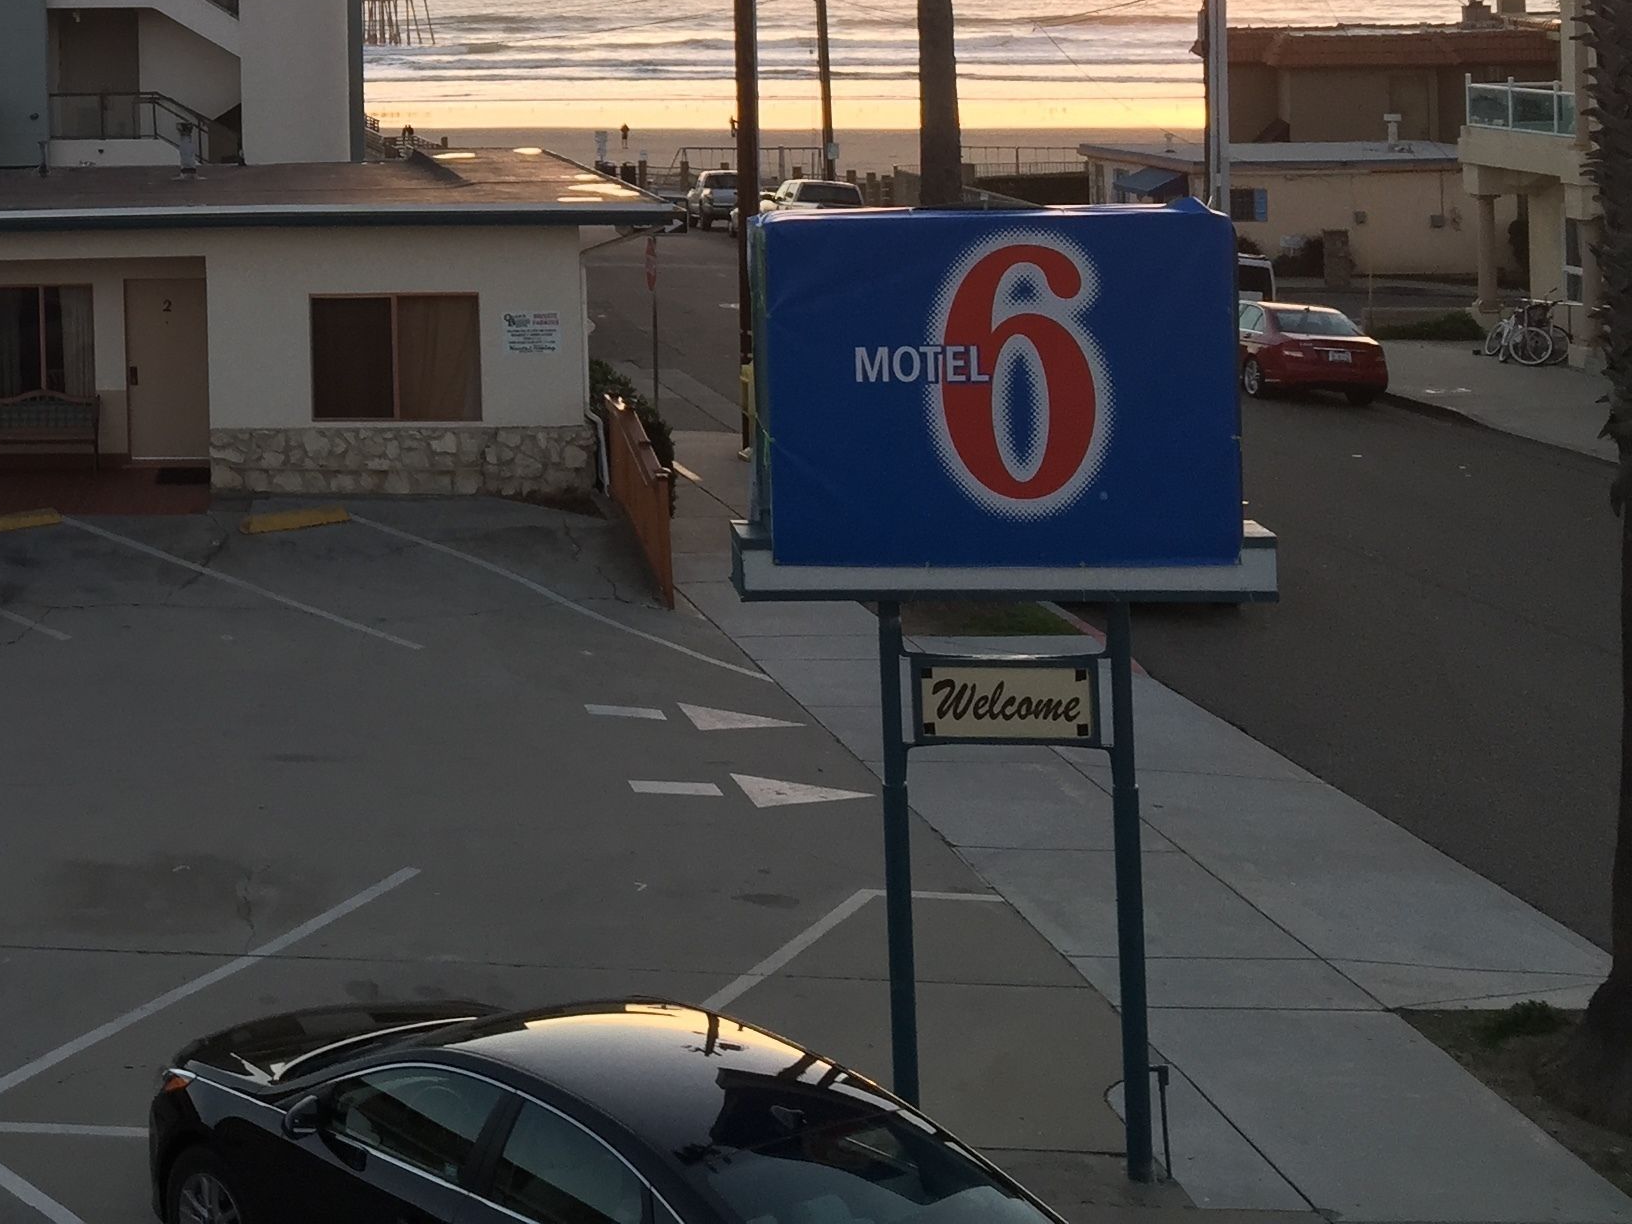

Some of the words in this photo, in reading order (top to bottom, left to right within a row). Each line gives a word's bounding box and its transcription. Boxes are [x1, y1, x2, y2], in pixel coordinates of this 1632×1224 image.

[163, 299, 172, 312] 2
[854, 345, 991, 384] MOTEL
[941, 242, 1097, 500] 6
[931, 678, 1081, 722] Welcome
